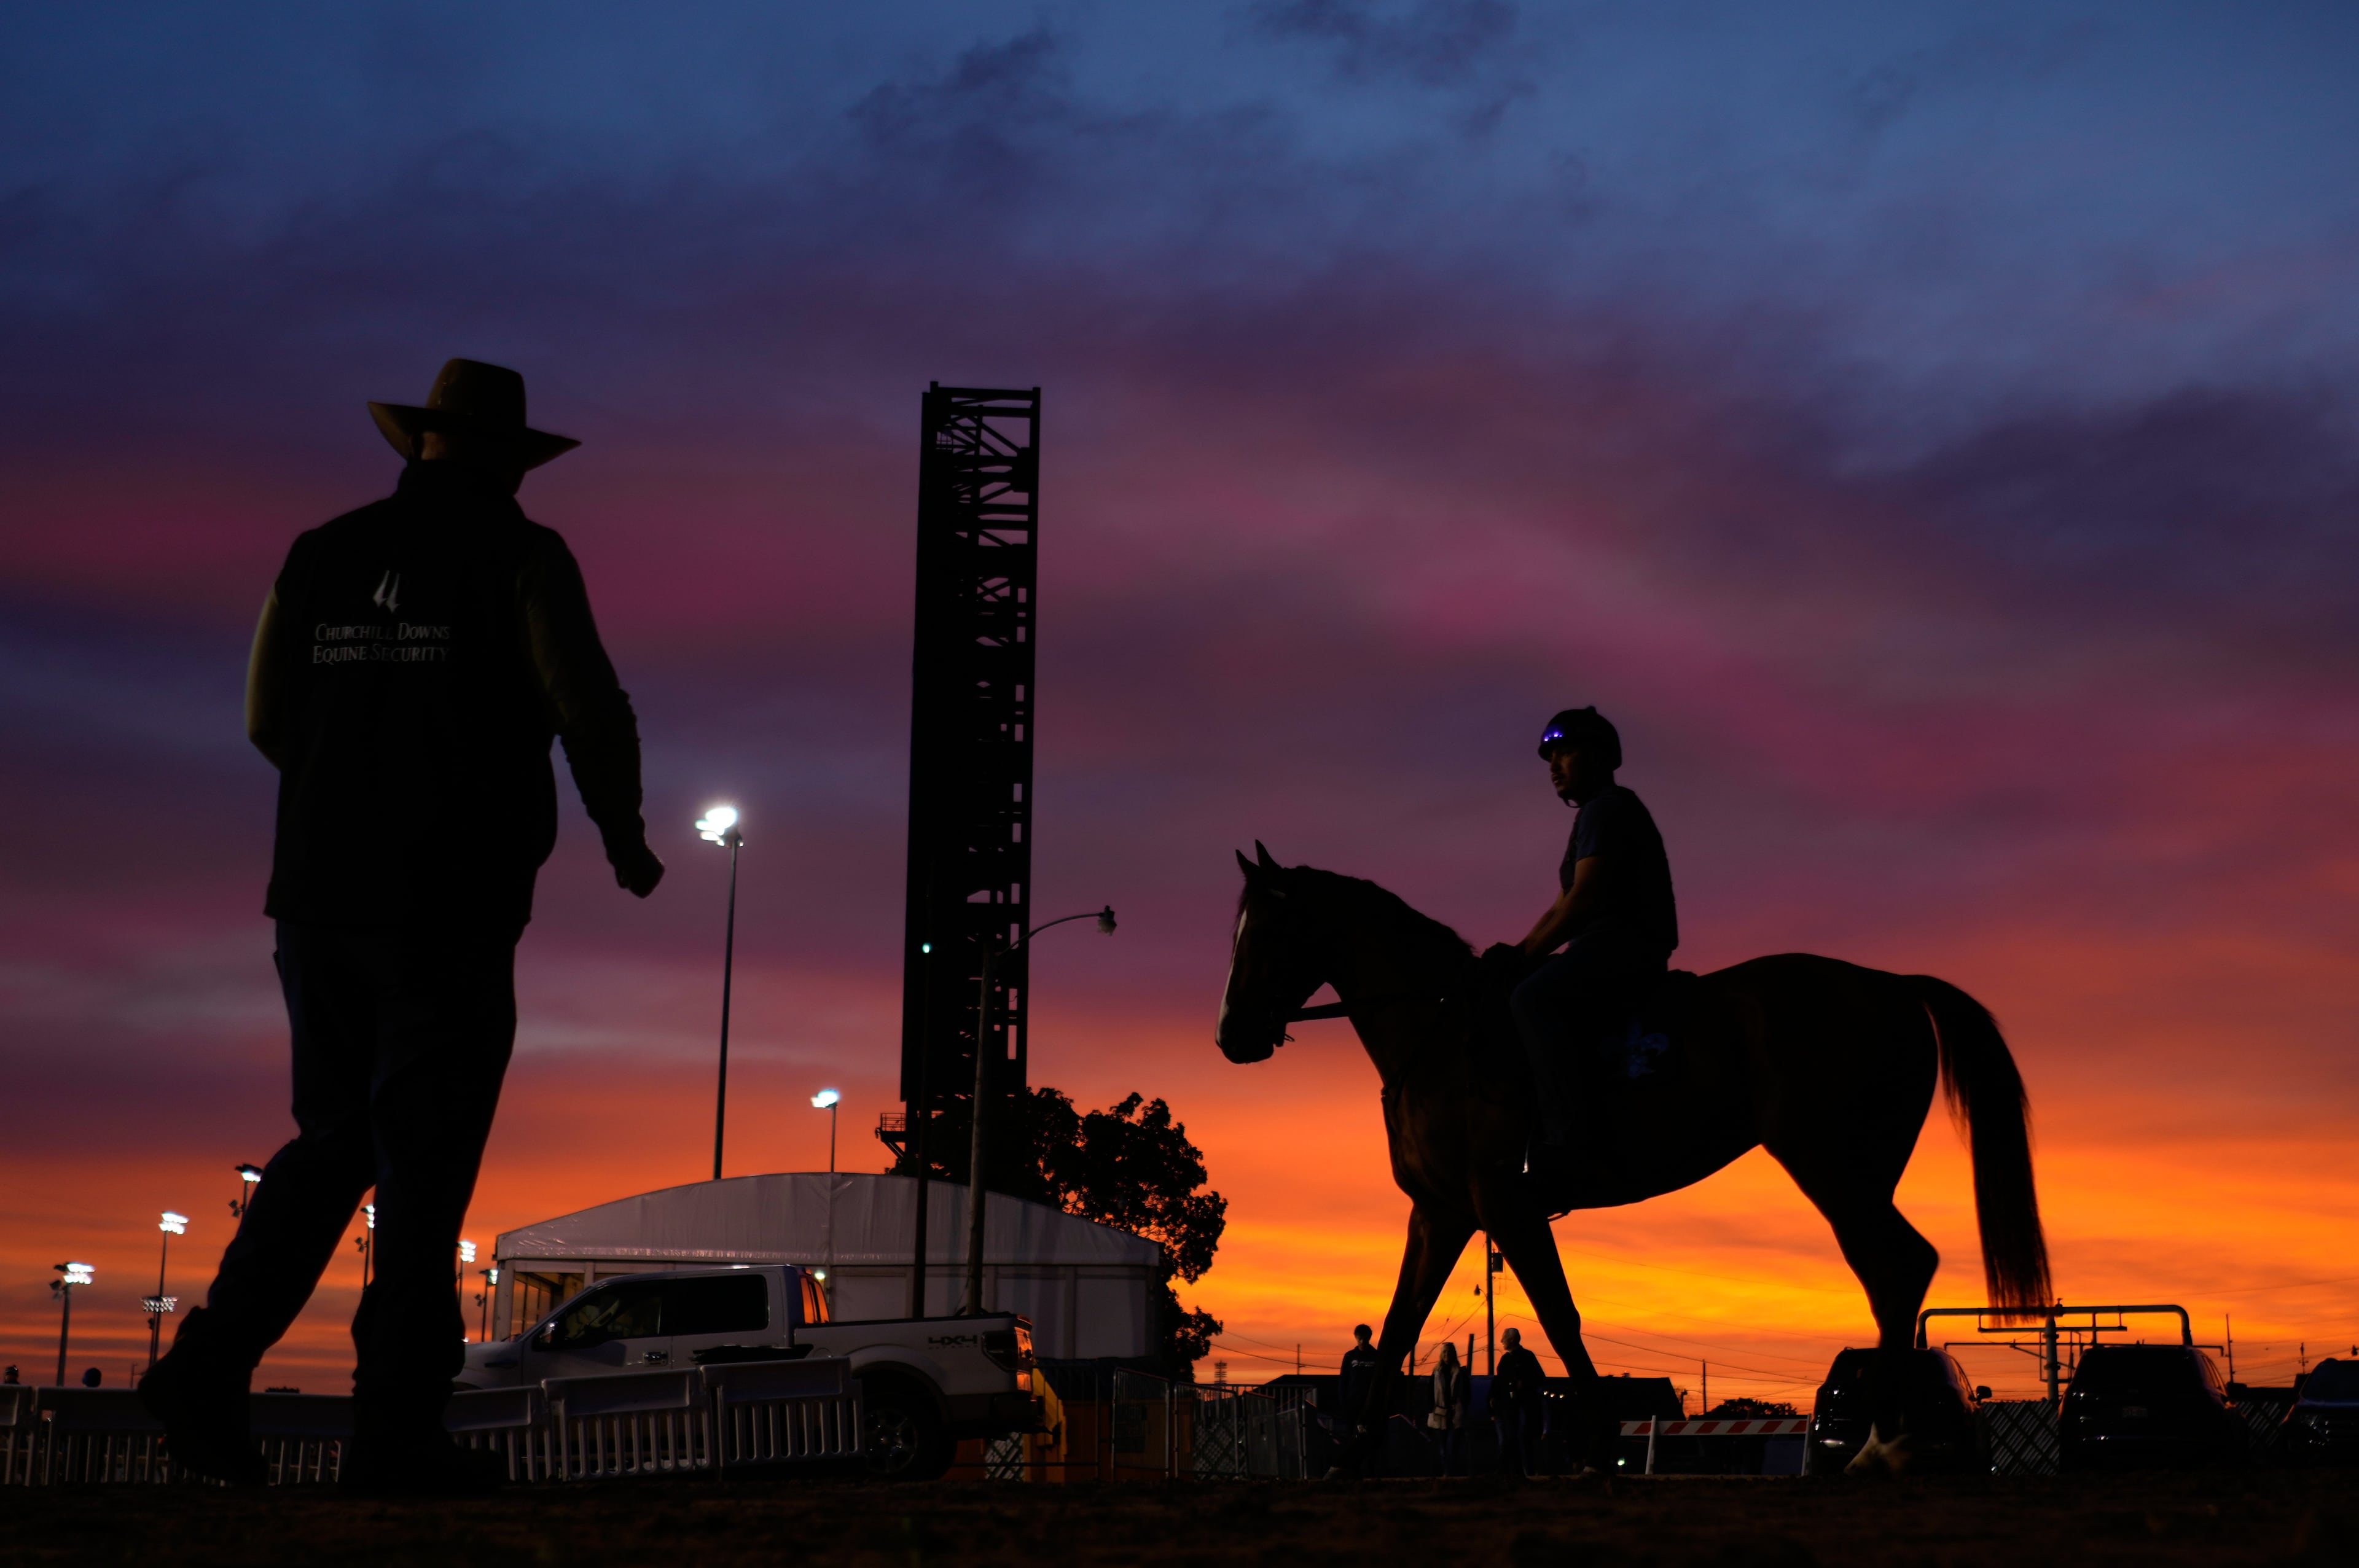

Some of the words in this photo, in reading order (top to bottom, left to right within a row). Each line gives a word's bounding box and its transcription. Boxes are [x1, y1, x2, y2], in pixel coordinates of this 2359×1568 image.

[315, 622, 394, 641] CHURCHILL
[397, 622, 452, 640] DOWNS
[312, 645, 368, 665] EQUINE
[369, 643, 450, 663] SECURITY
